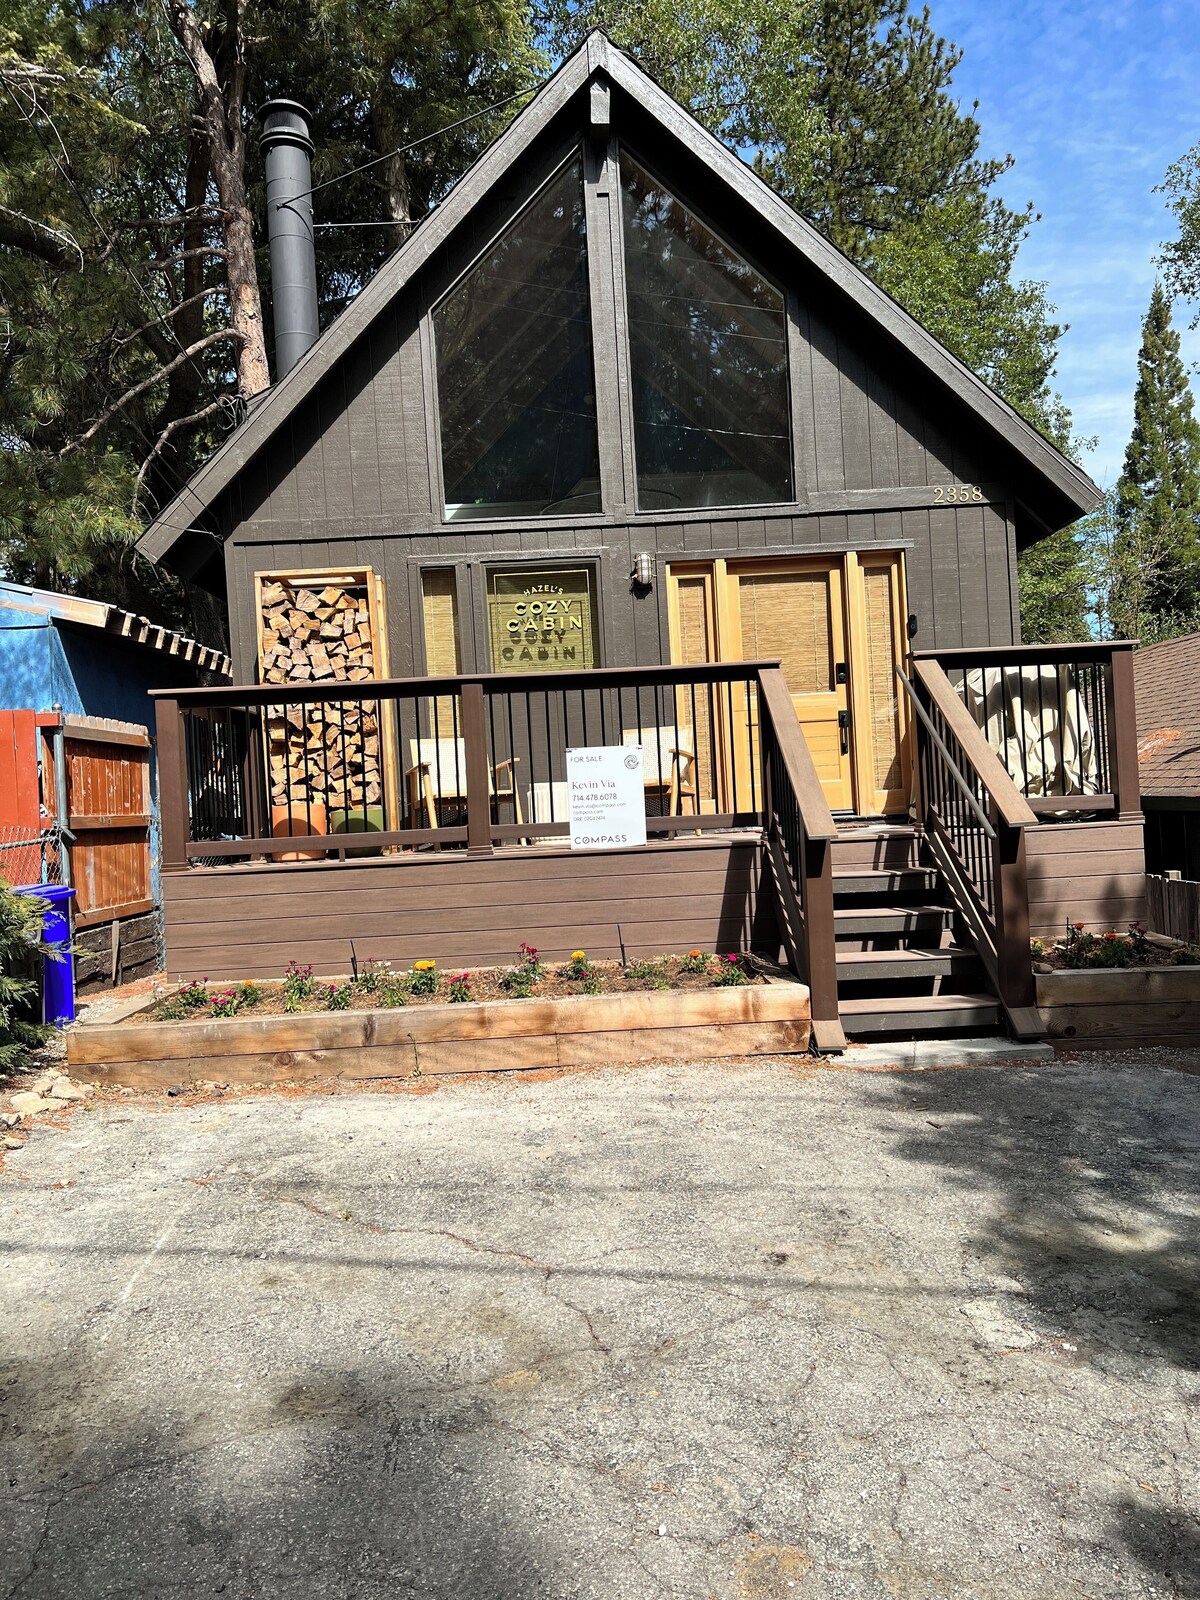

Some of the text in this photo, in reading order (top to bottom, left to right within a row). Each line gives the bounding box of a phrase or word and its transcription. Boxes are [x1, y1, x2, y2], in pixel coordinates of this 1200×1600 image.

[933, 486, 983, 503] 2358
[523, 584, 564, 597] HAZEL'S
[513, 599, 572, 615] COZY
[506, 615, 582, 632] CABIN
[586, 755, 603, 763] SALE
[572, 779, 616, 790] Kevin Via
[573, 793, 618, 801] 714.478.6078
[574, 834, 628, 845] COMPASS
